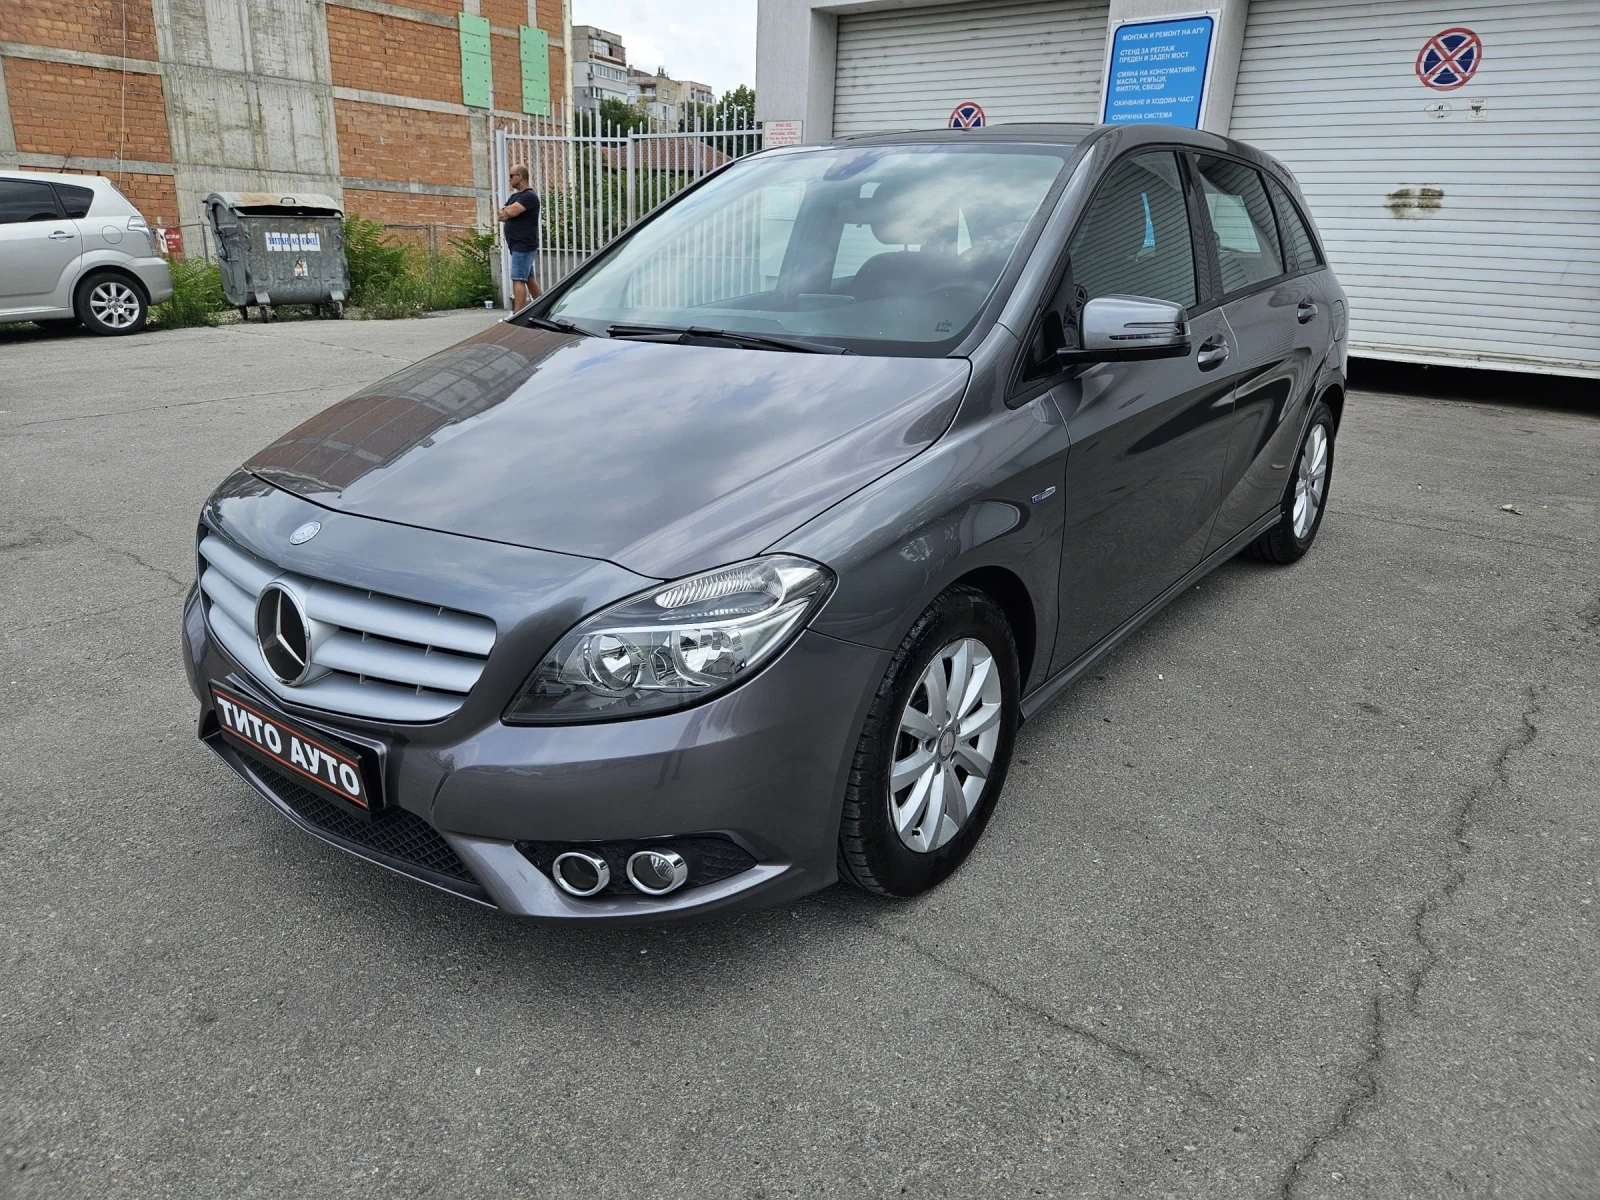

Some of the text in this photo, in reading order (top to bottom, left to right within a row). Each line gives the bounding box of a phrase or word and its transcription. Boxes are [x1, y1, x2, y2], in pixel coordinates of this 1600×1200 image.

[1122, 33, 1149, 41] МОНТАЖ
[1155, 30, 1180, 38] РЕМОНТ
[1120, 48, 1140, 56] СТЕНД
[1150, 45, 1176, 53] РЕГЛАЖ
[1149, 53, 1171, 61] ЗАДЕН
[1149, 66, 1197, 75] КОНСУМАТИВИ-
[1142, 83, 1165, 91] СВЕЩИ
[1113, 98, 1145, 106] ОКАЧВАНЕ
[1112, 113, 1143, 121] СПИРАЧНА
[216, 695, 360, 796] ТИТО АУТО
